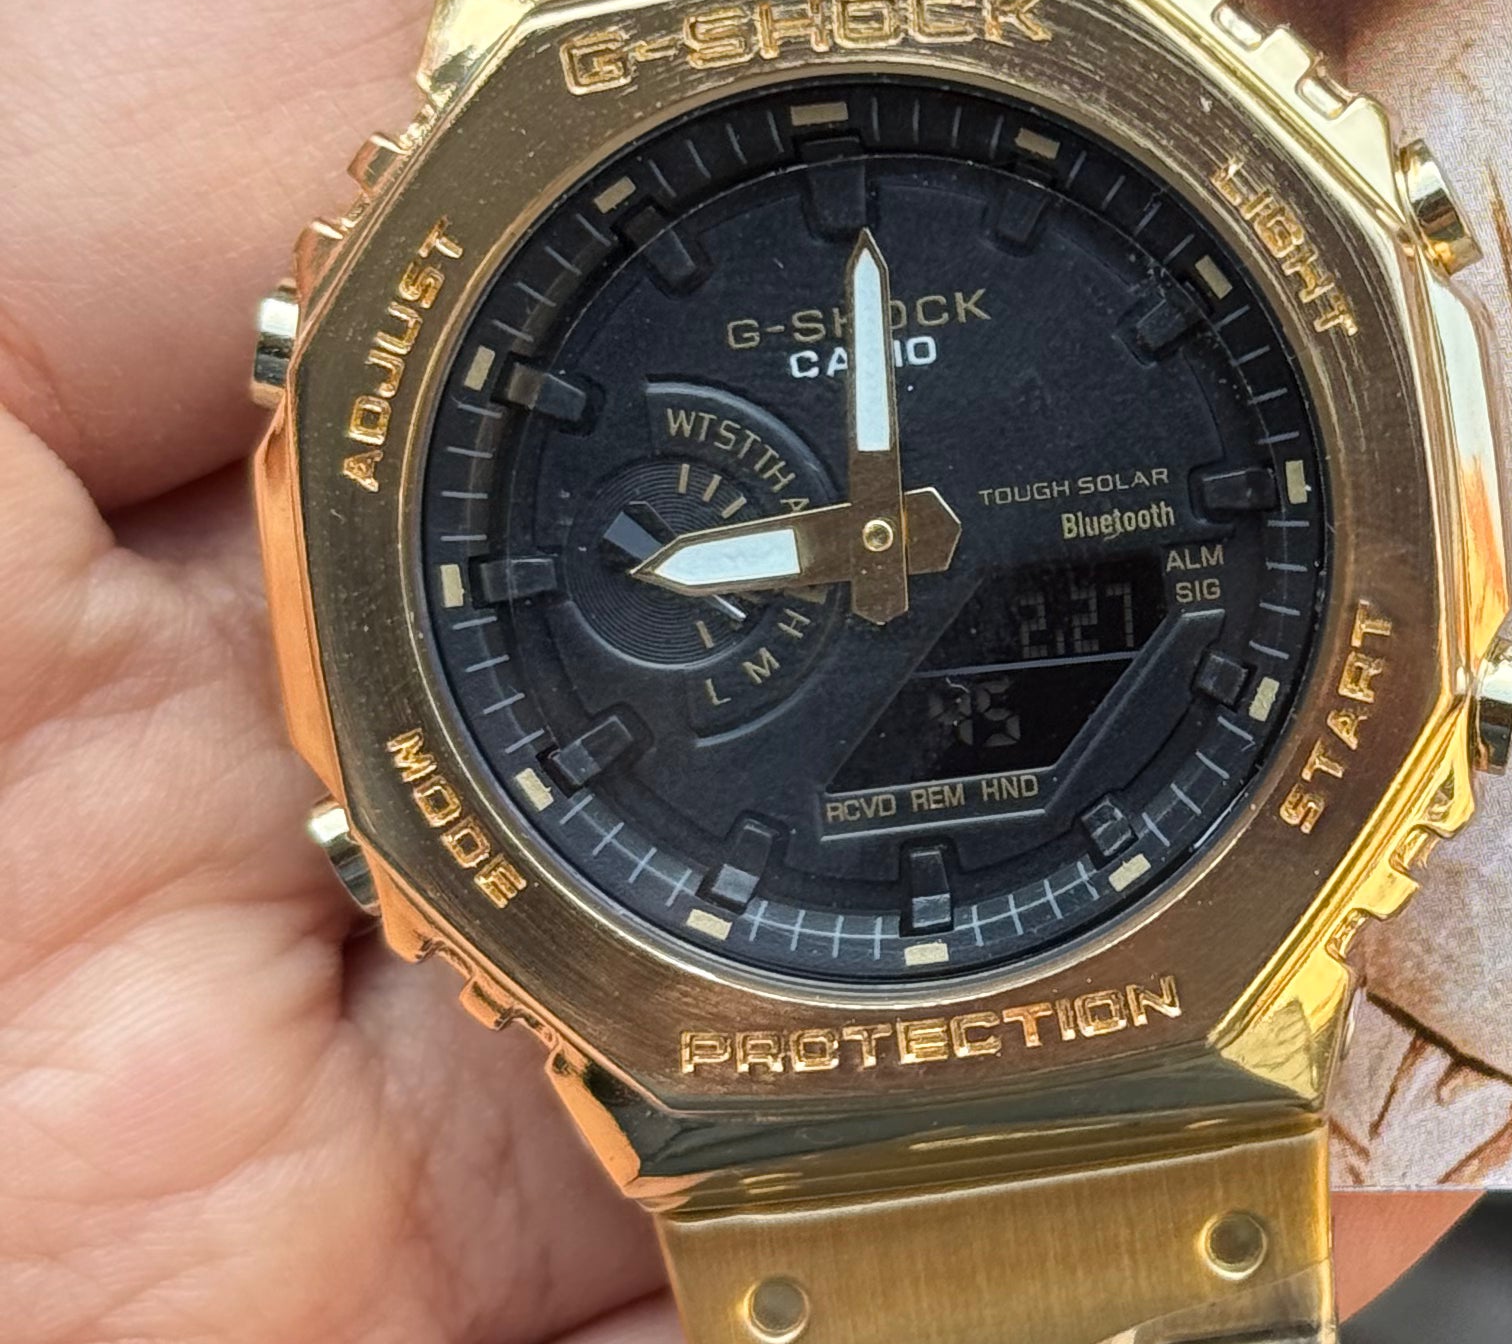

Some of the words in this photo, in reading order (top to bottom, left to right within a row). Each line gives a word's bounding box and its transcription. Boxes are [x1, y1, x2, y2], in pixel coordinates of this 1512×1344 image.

[1209, 156, 1359, 337] LIGHT
[343, 216, 465, 492] ADJUST
[789, 335, 937, 378] CAIO
[979, 480, 1070, 506] TOUGH
[1077, 468, 1169, 495] SOLAR
[1061, 501, 1175, 542] Bluetooth
[1166, 544, 1225, 572] ALM
[1175, 578, 1221, 603] SIG
[1279, 599, 1393, 833] START
[386, 727, 527, 908] MODE
[826, 794, 897, 824] RCVD
[911, 783, 965, 812] REM
[981, 774, 1039, 802] HND
[679, 975, 1182, 1074] PROTECTION
